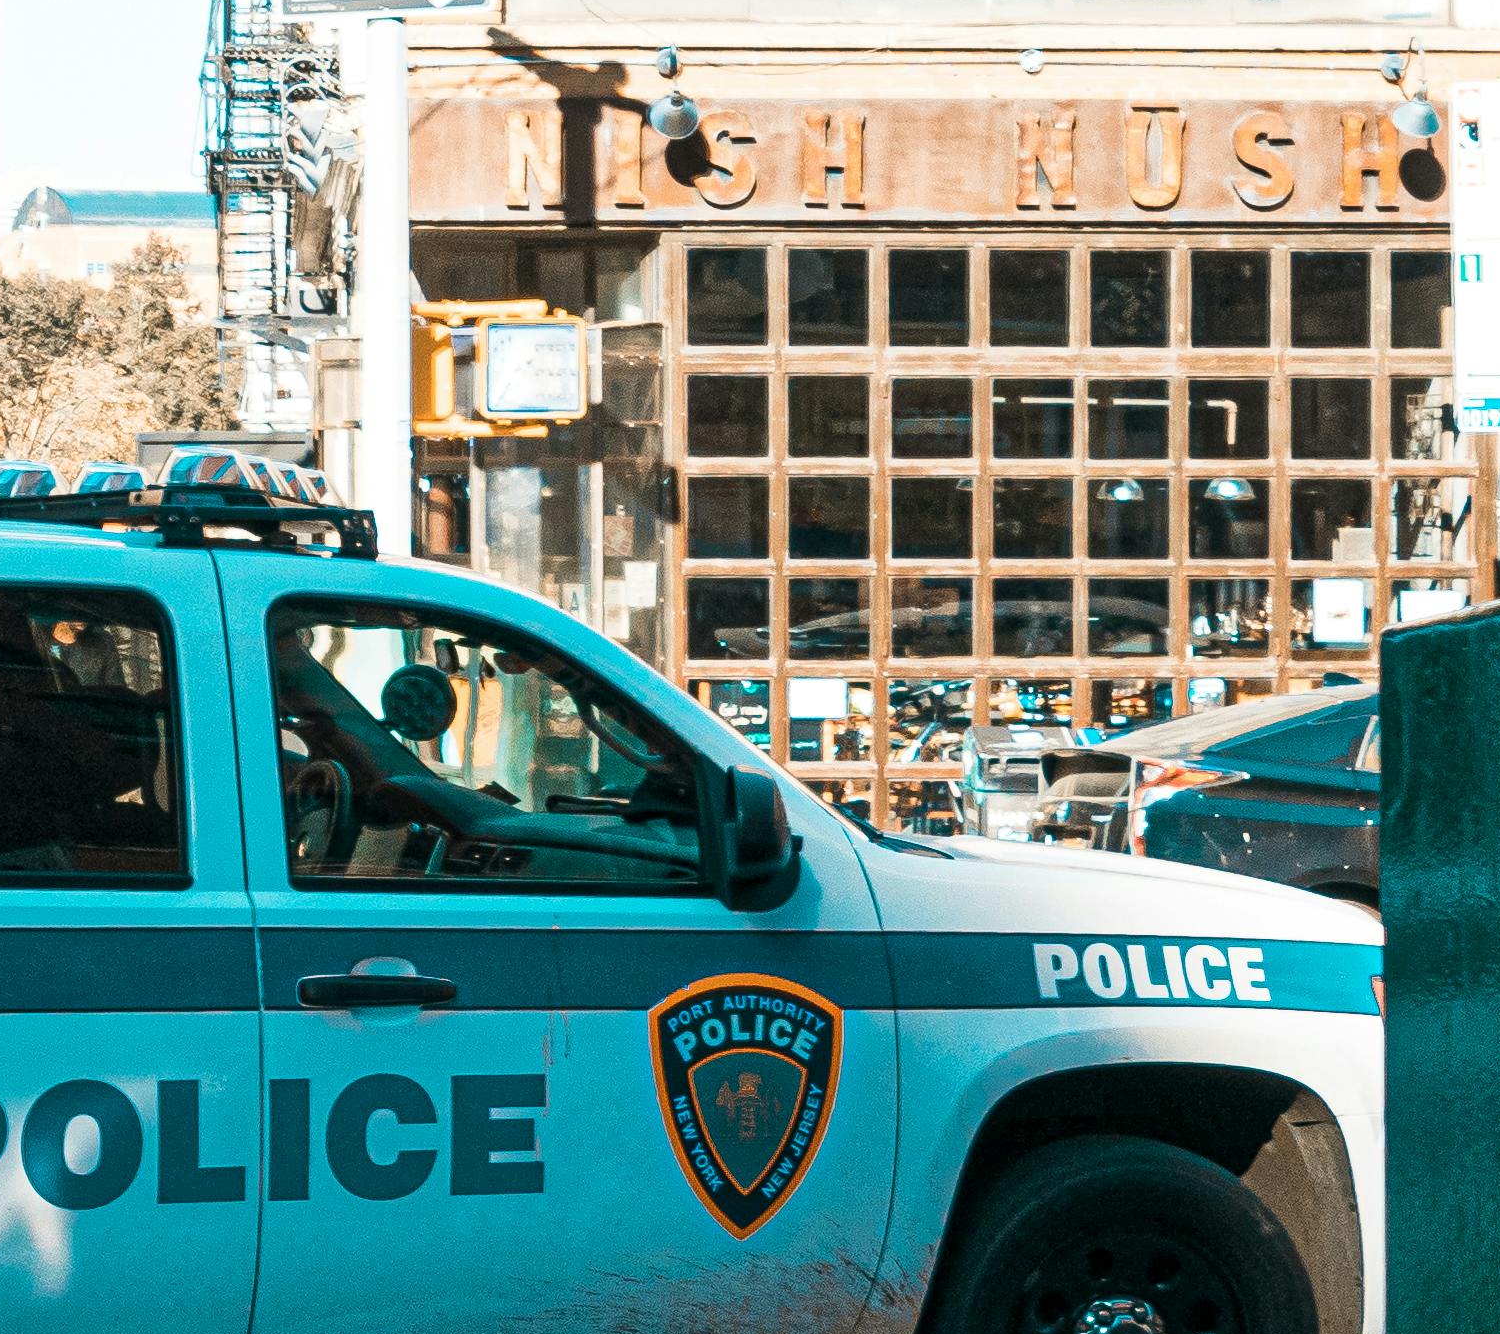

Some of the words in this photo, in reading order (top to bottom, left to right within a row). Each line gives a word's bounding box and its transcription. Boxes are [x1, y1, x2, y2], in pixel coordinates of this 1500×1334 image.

[505, 108, 867, 212] NISH
[1033, 942, 1272, 1002] POLICE
[667, 1000, 714, 1033] PORT
[722, 994, 827, 1032] AUTHORITY
[672, 1013, 820, 1062] POLICE
[673, 1095, 696, 1141] NEW
[692, 1143, 726, 1193] YORK
[761, 1159, 794, 1198] NEW
[794, 1083, 824, 1157] JERSEY
